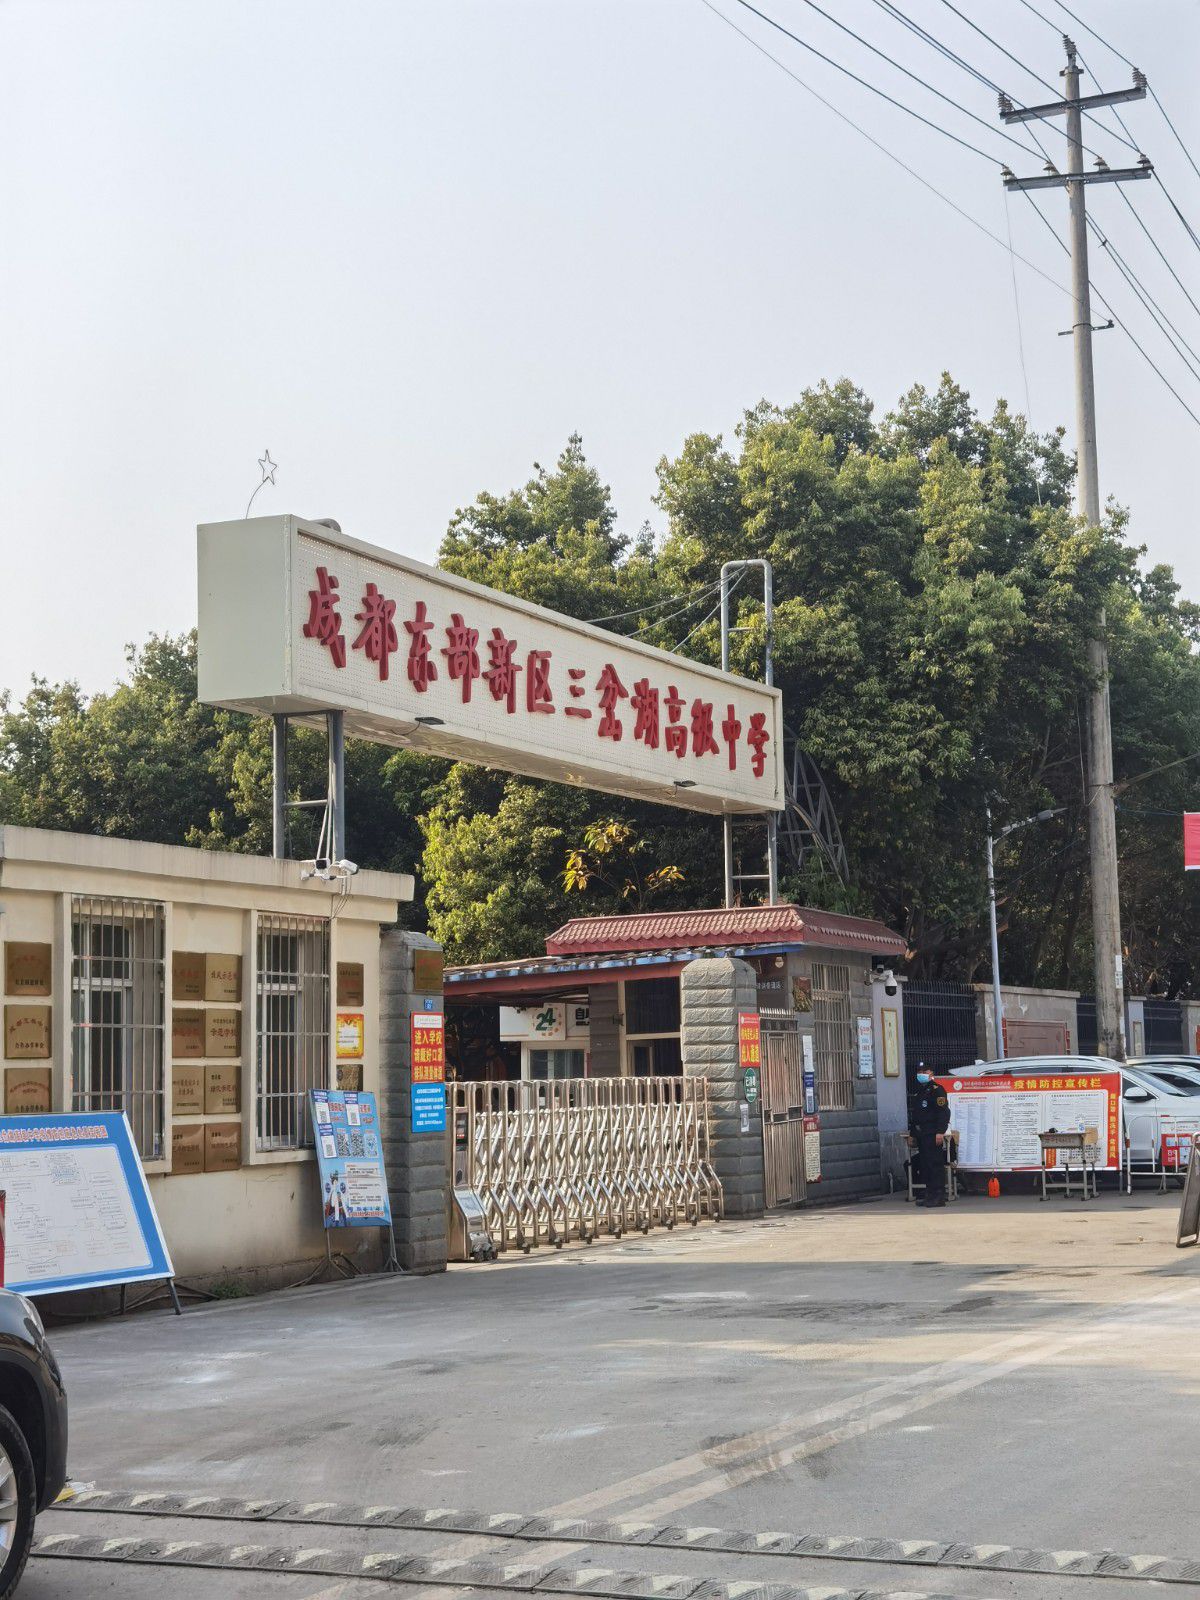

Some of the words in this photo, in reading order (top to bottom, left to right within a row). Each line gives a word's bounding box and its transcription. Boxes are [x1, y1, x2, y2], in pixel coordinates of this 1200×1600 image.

[303, 566, 769, 778] 成都东部新区三岔湖高级中学
[536, 1007, 556, 1031] 24
[414, 1029, 442, 1045] 进入学校
[1013, 1077, 1101, 1090] 疫情防控宣传栏
